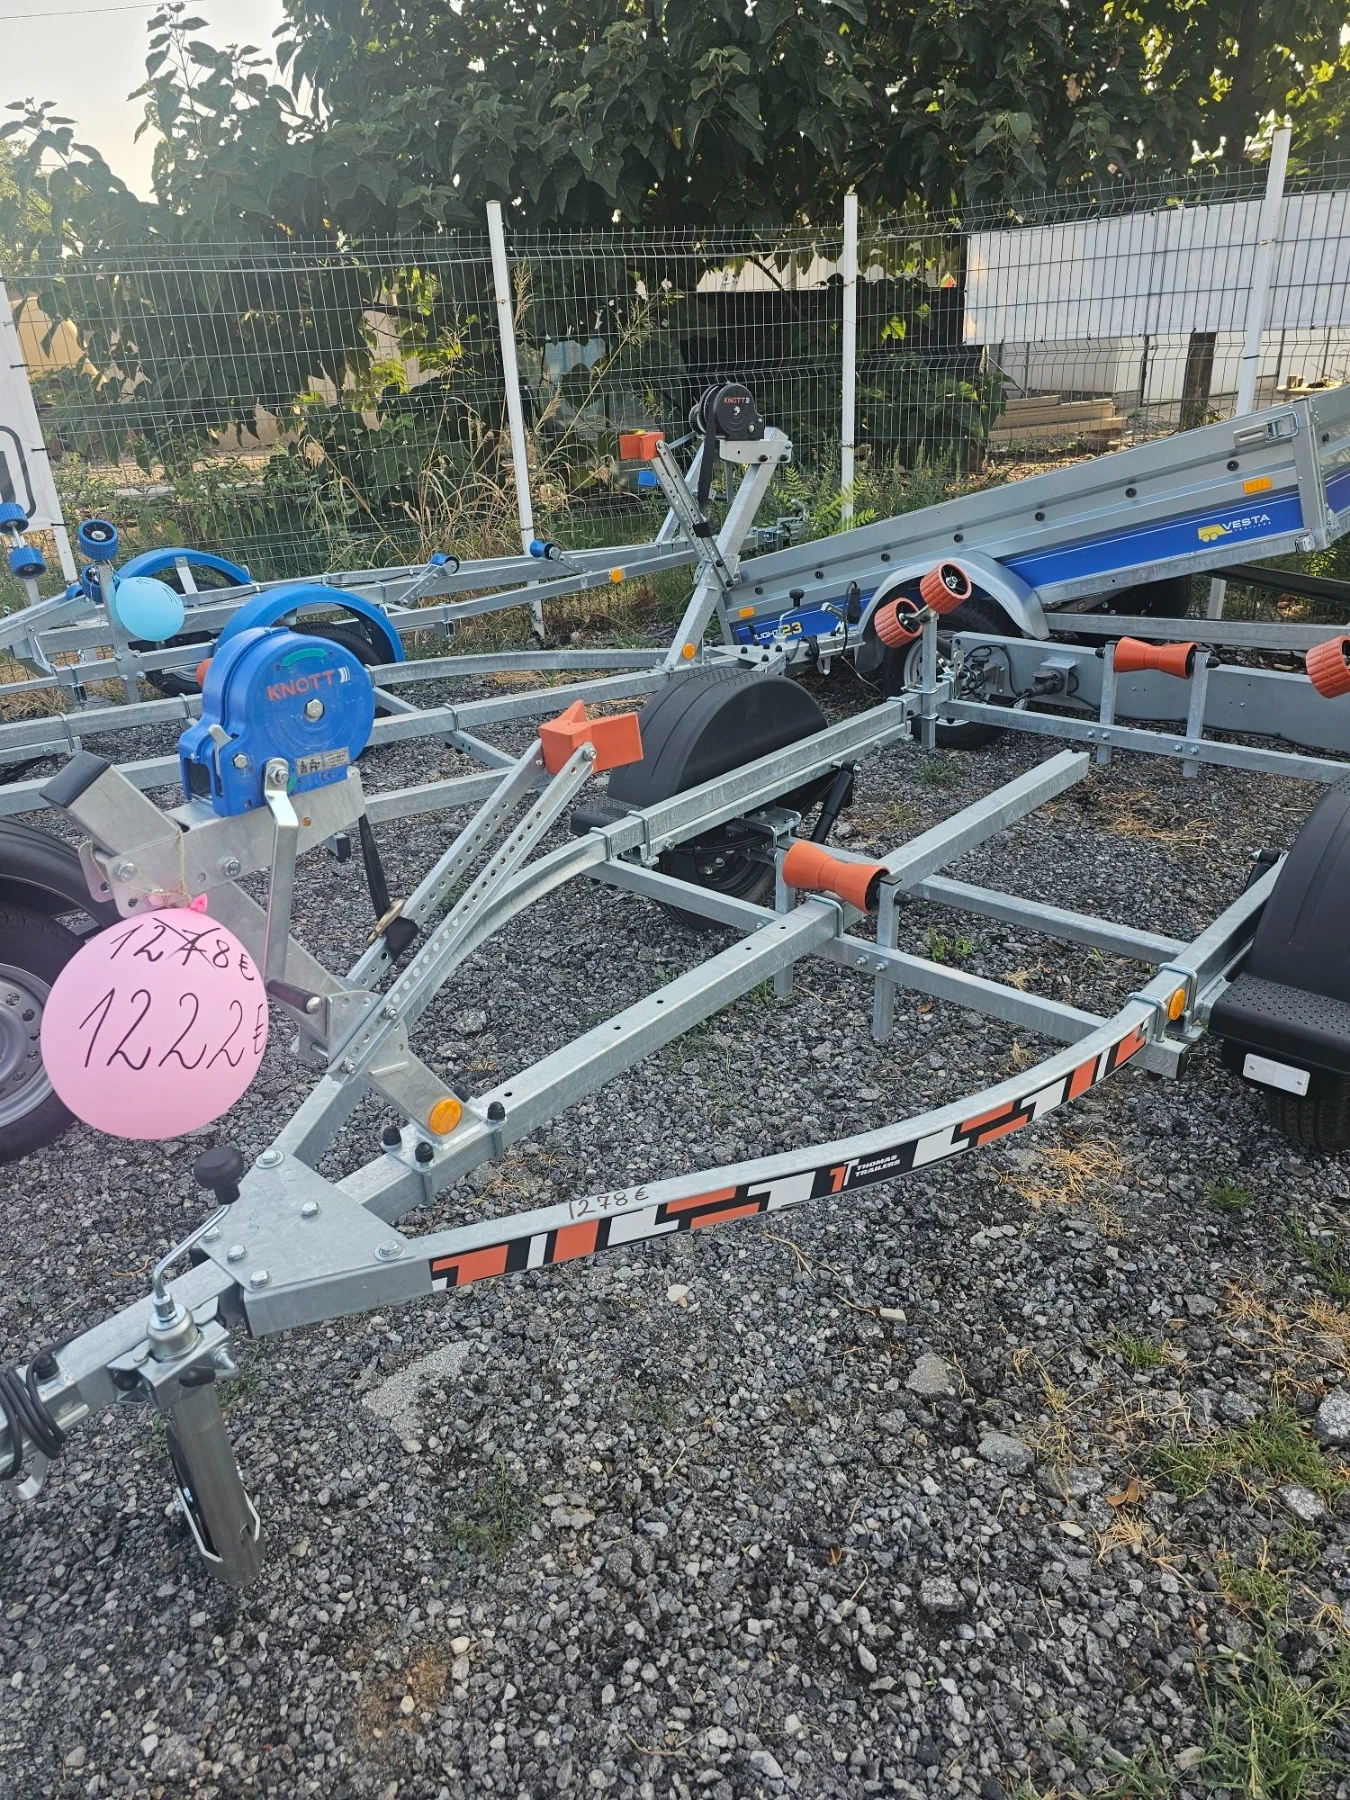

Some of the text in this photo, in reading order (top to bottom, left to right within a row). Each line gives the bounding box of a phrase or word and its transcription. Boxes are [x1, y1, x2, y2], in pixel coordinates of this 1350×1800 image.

[723, 396, 746, 404] KNOTT
[1222, 514, 1270, 530] VESTA
[782, 621, 803, 636] 23
[266, 669, 336, 702] KNOTT
[855, 1159, 901, 1177] TRAILERS
[856, 1154, 898, 1171] THOMAS
